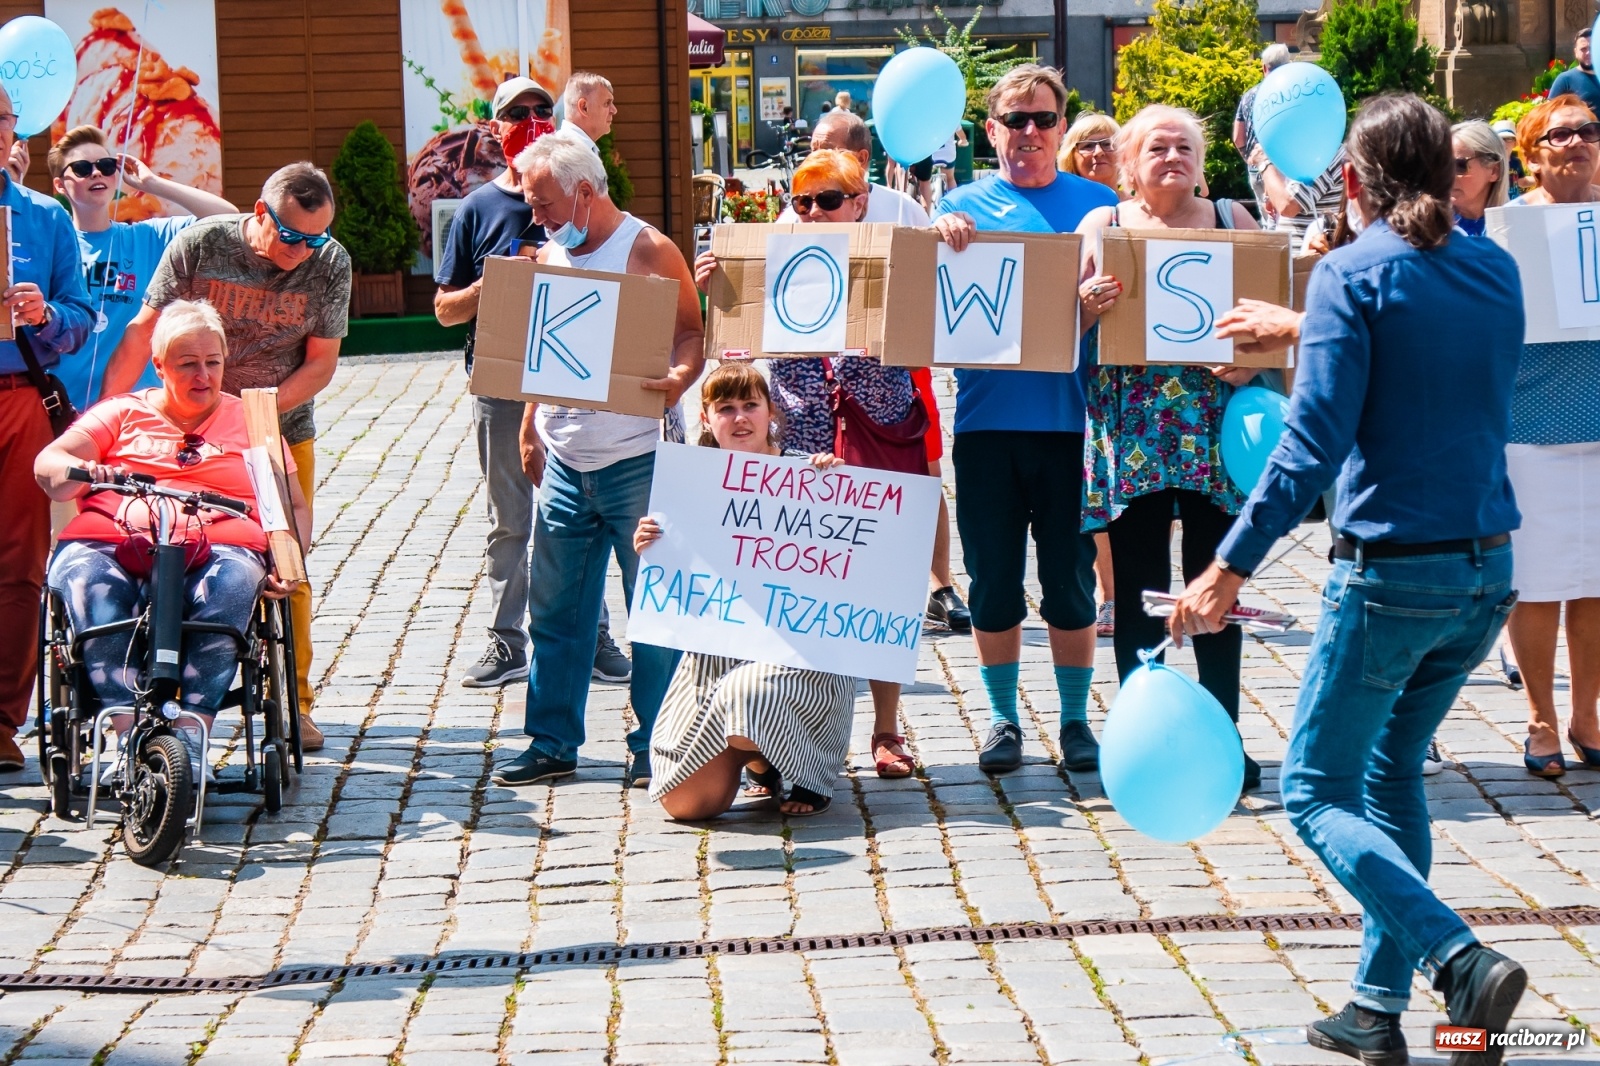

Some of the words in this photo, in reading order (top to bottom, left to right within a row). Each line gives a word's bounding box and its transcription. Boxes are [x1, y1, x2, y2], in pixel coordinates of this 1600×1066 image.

[0, 51, 58, 80] DOŚĆ
[207, 279, 309, 326] DIVERSE
[773, 245, 844, 335] O
[937, 256, 1018, 337] W
[1152, 251, 1215, 344] S
[528, 282, 602, 381] K
[721, 453, 903, 516] LEKARSTWEM
[721, 498, 763, 531] NA
[773, 504, 879, 546] NASZE
[640, 565, 746, 625] RAFAŁ
